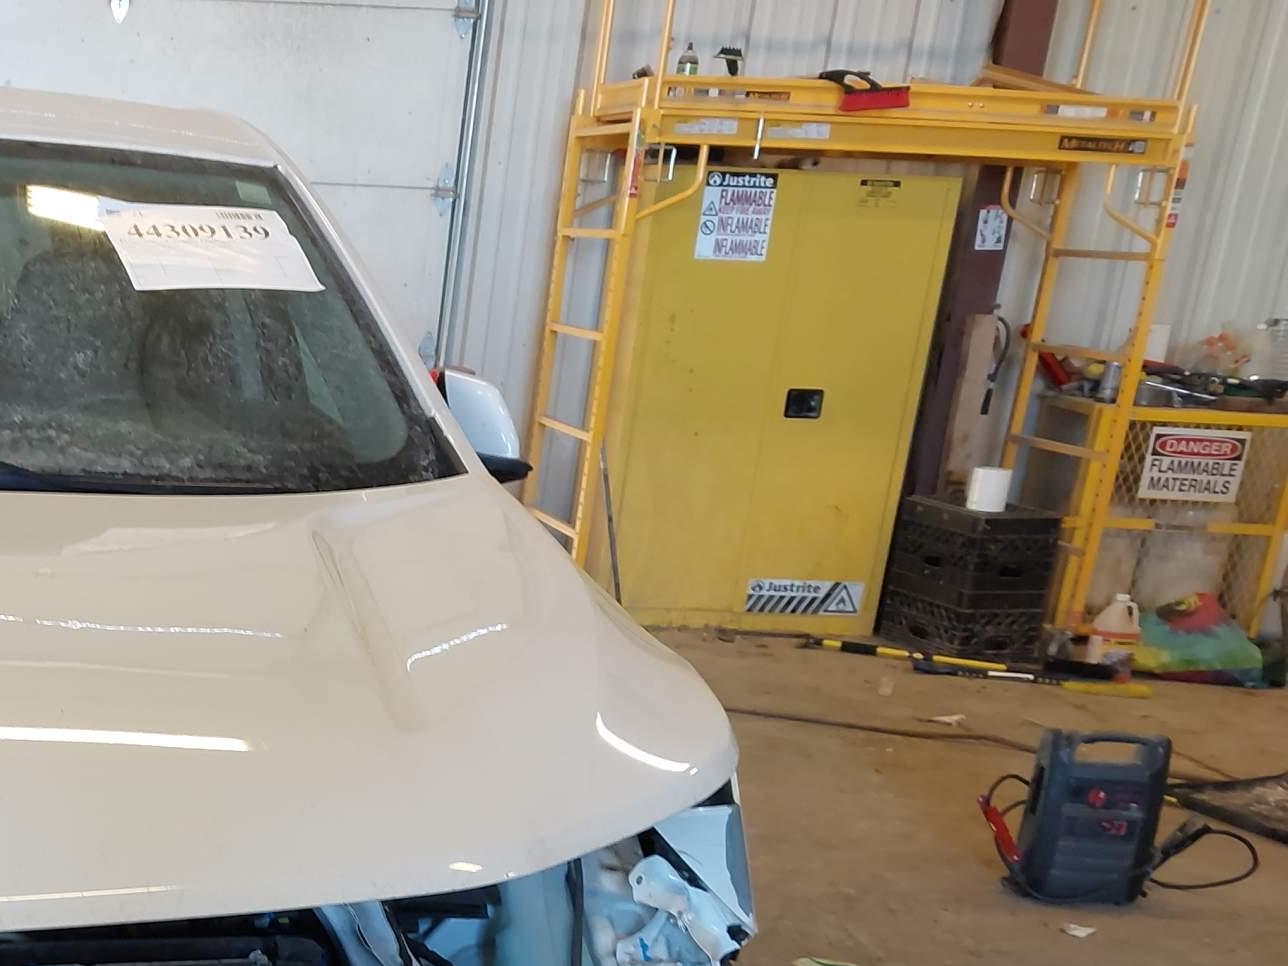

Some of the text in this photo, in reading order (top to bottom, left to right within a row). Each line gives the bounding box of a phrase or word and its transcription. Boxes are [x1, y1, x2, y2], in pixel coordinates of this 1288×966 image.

[723, 173, 775, 187] Justrite
[720, 189, 775, 207] FLAMMABLE
[127, 222, 271, 240] 44309139
[717, 216, 770, 234] INFLAMABLE
[1165, 439, 1232, 455] DANGER
[1149, 458, 1239, 477] FLAMMABLE
[1147, 476, 1231, 495] MATERIALS
[767, 582, 821, 594] Justrite
